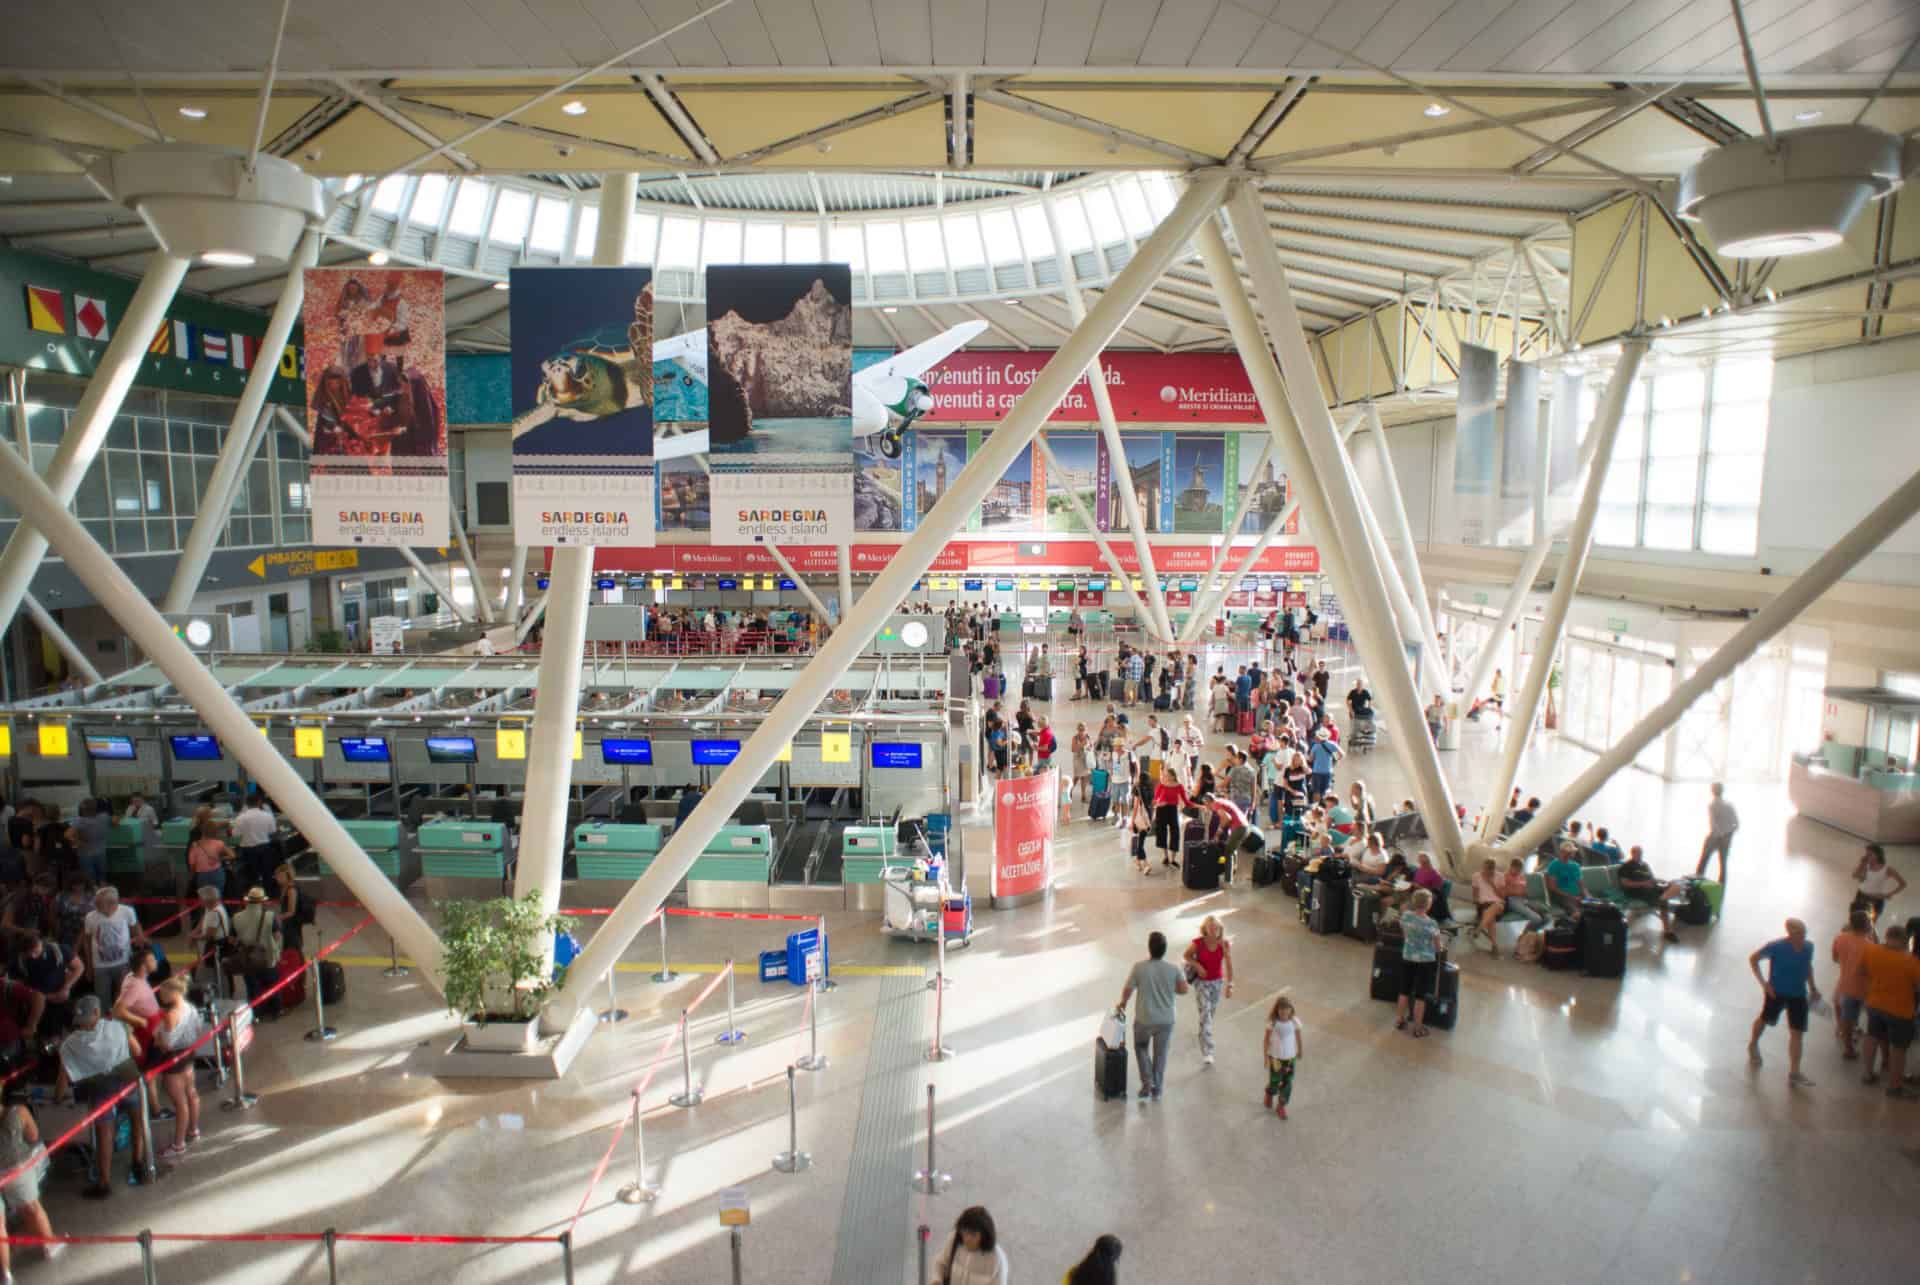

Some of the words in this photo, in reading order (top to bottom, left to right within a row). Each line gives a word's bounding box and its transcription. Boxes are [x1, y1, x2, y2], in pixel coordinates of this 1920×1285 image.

[985, 366, 1000, 385] in
[1179, 387, 1257, 402] Meridiana
[986, 395, 995, 409] a
[338, 511, 424, 523] SARDEGNA
[541, 511, 629, 524] SARDEGNA
[738, 510, 827, 522] SARDEGNA
[338, 524, 384, 536] endless
[388, 524, 424, 537] island
[541, 525, 589, 537] endless
[592, 525, 629, 537] island
[738, 523, 785, 536] endless
[791, 523, 827, 536] island
